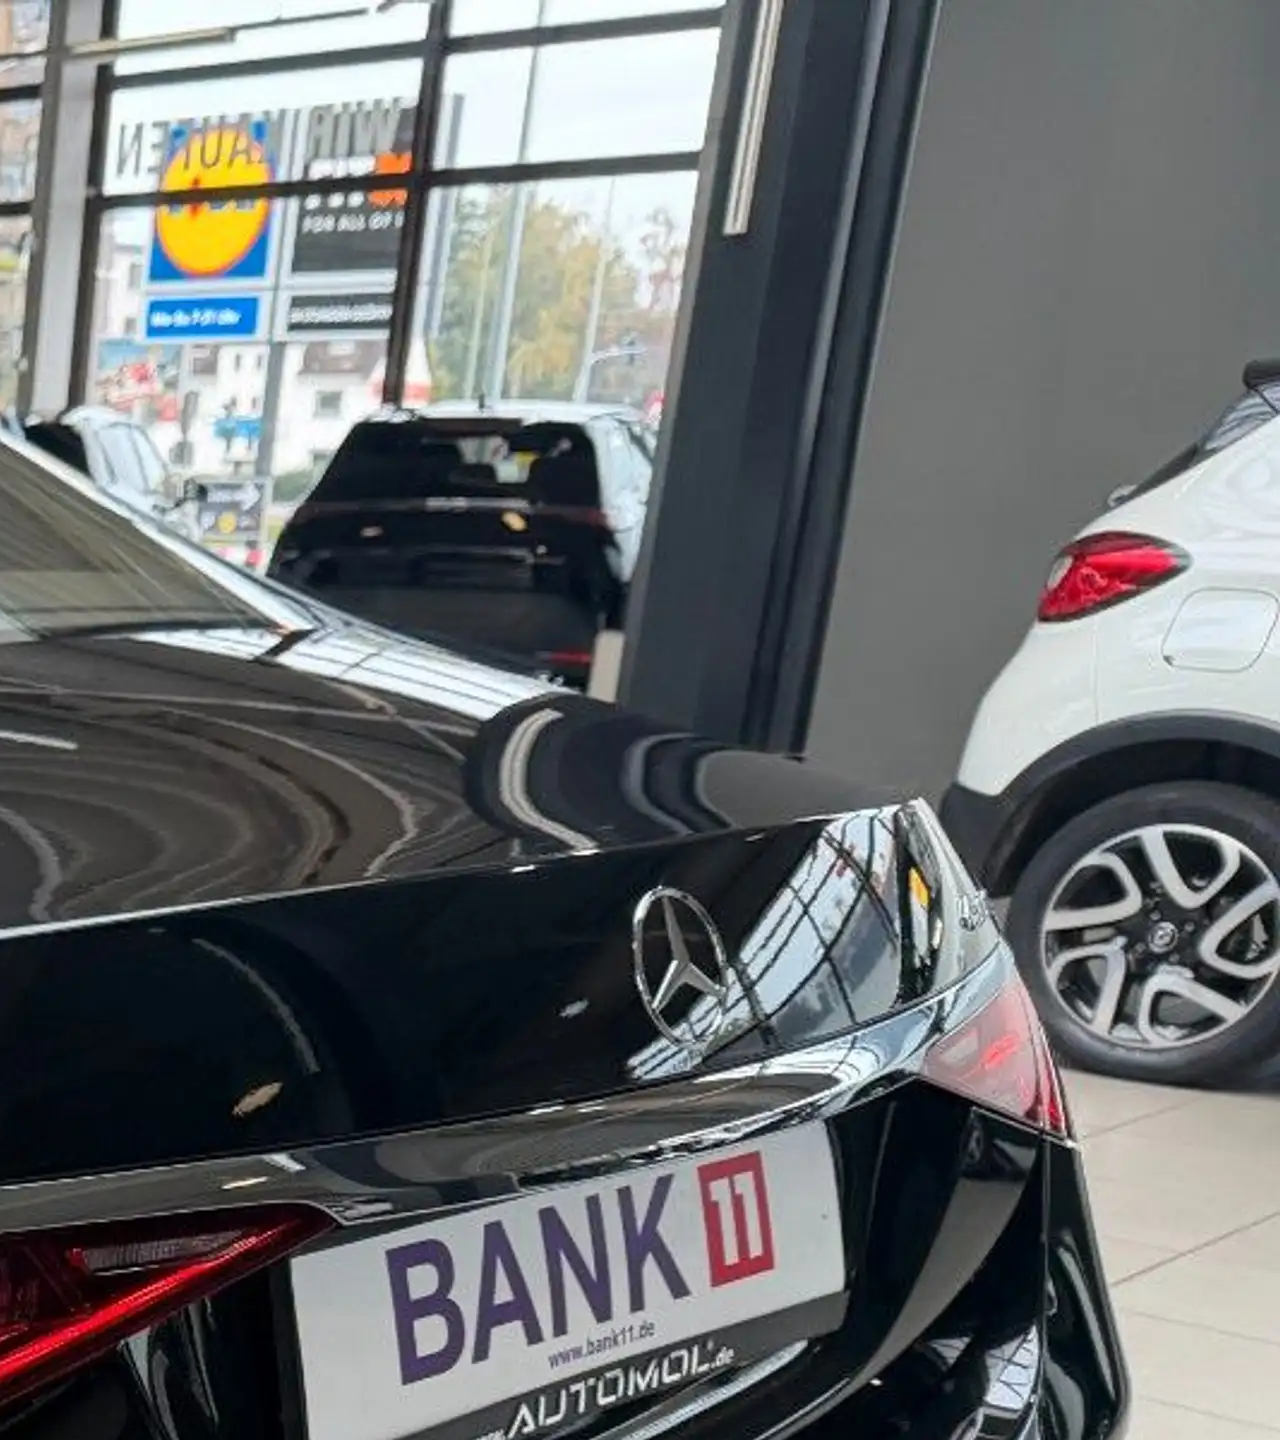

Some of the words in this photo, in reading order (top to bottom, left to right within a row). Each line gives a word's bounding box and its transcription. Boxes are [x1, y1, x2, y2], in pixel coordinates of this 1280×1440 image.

[386, 1174, 691, 1386] BANK
[706, 1166, 766, 1272] 11
[547, 1321, 655, 1370] www.bank11.de
